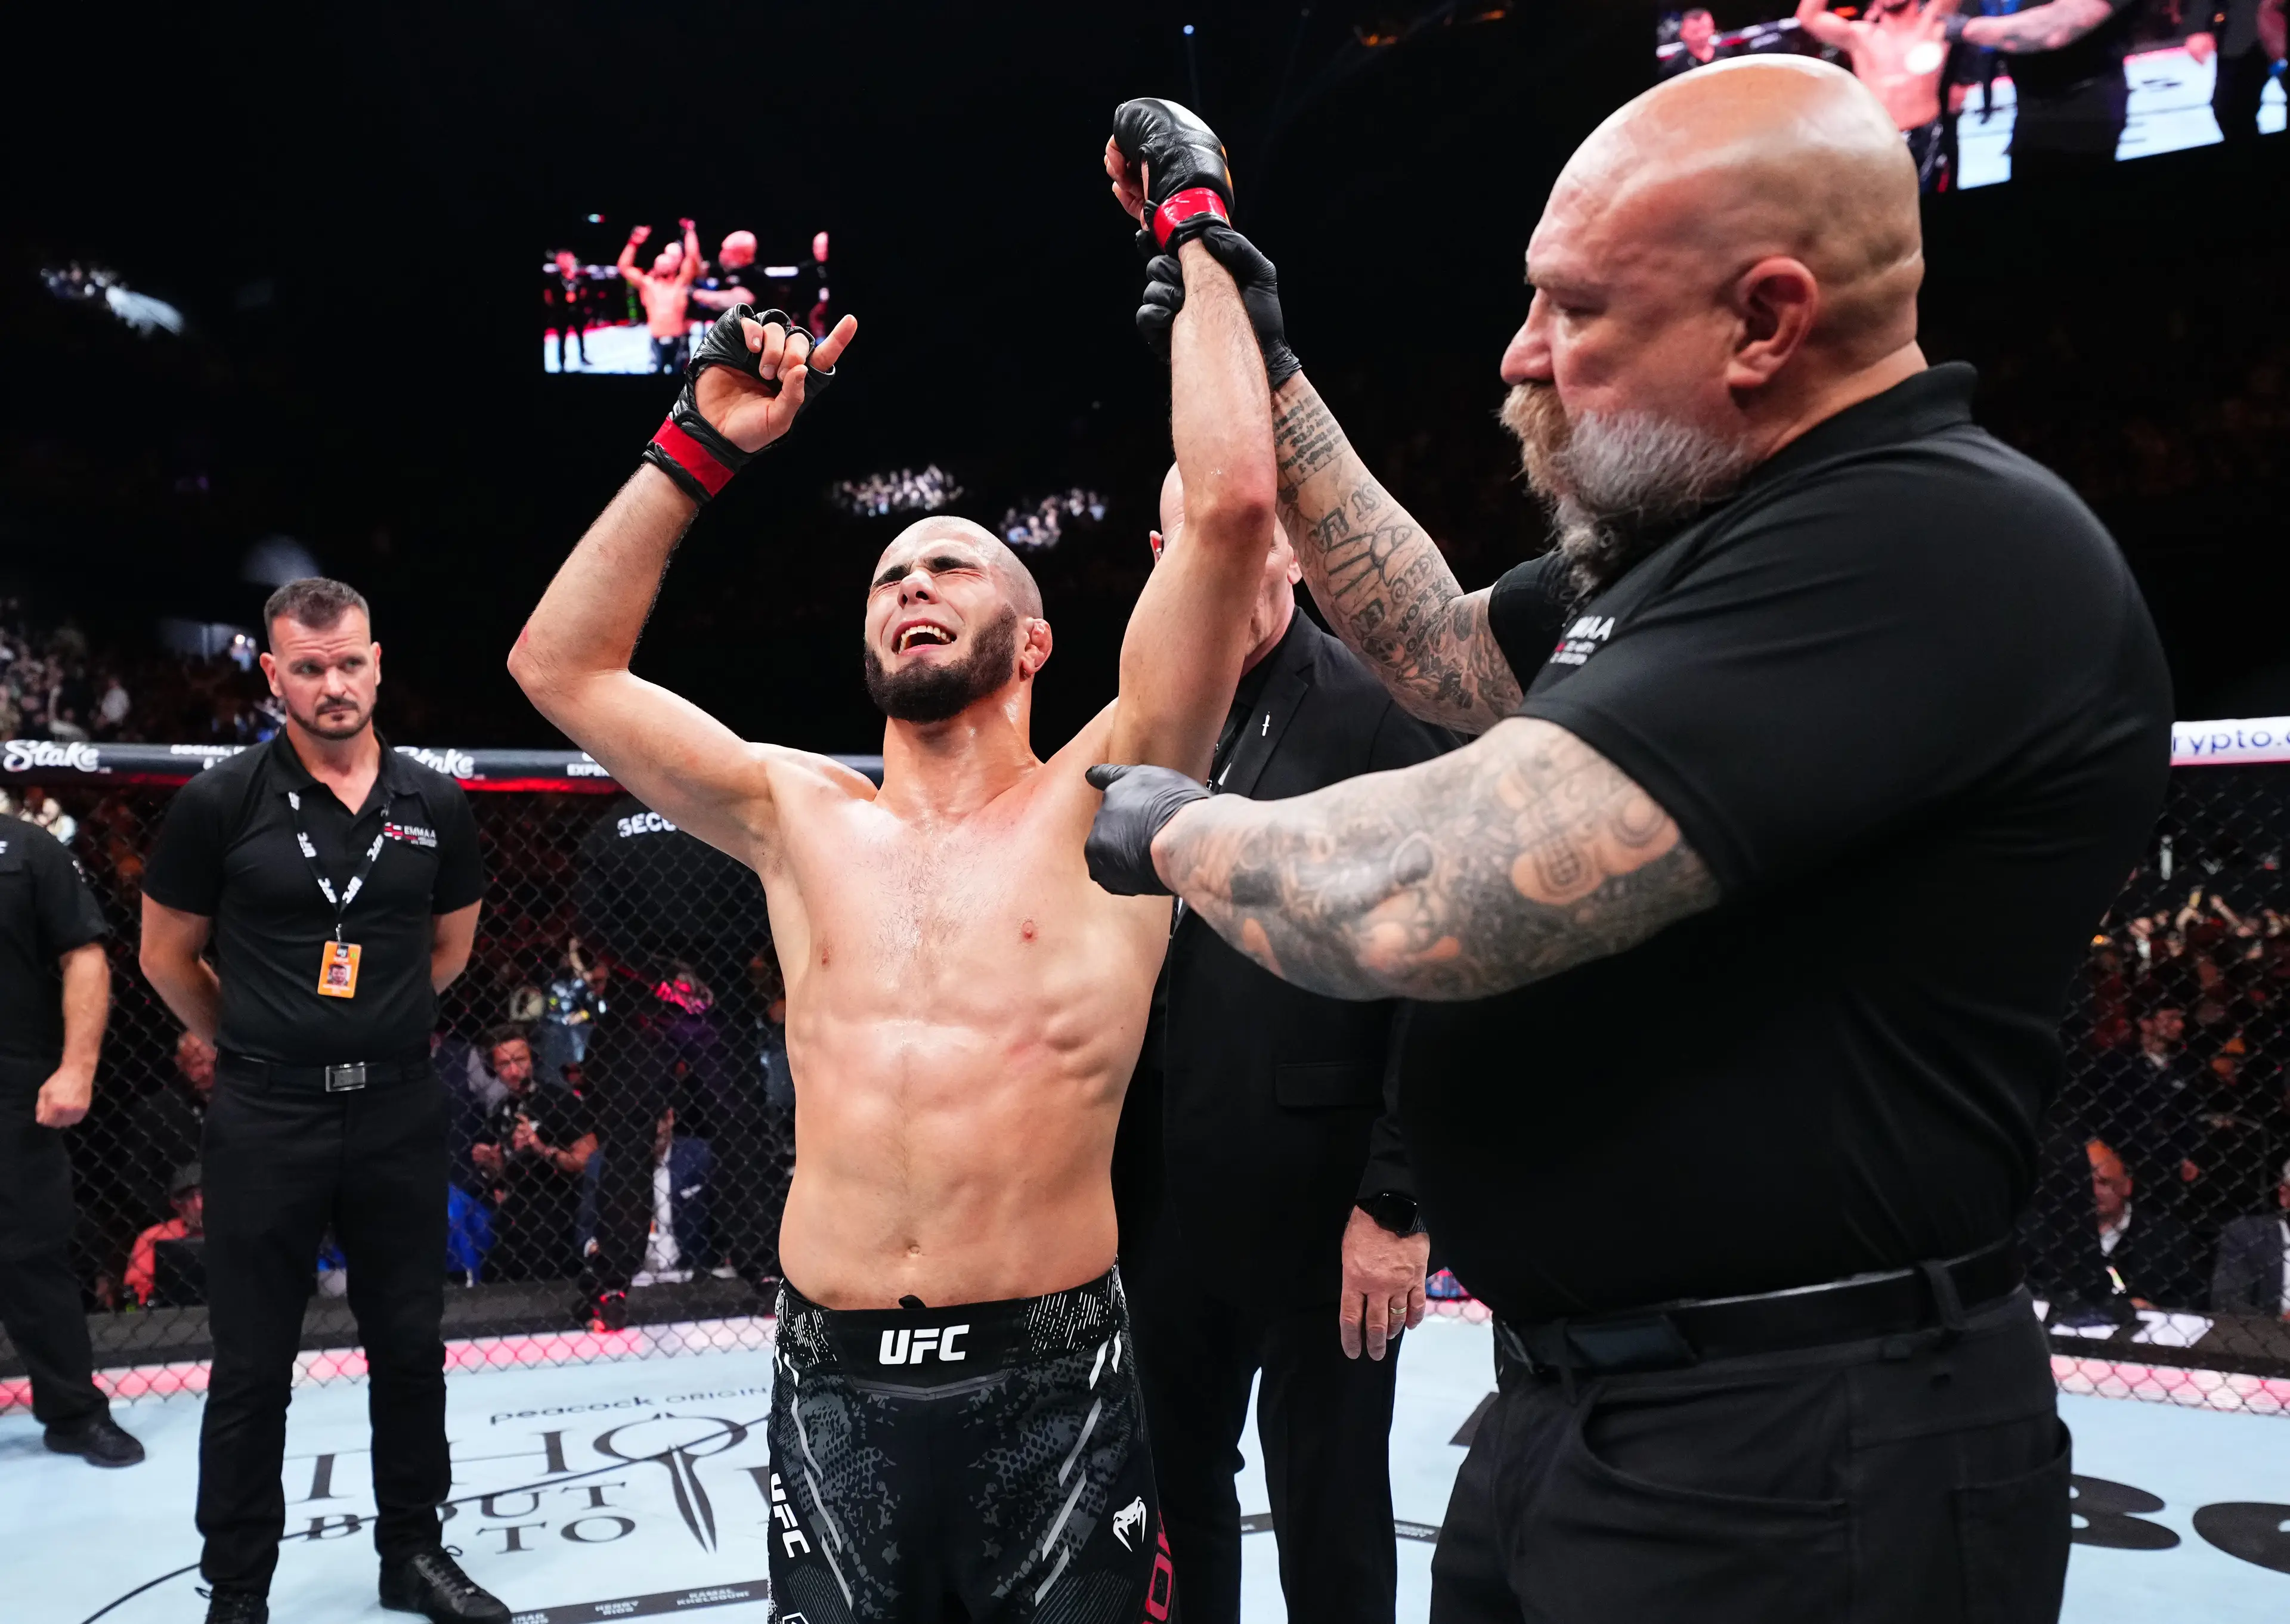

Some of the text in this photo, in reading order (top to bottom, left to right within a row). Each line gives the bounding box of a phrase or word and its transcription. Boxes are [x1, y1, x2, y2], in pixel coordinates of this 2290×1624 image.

[3, 739, 100, 773] Stake
[2171, 729, 2290, 755] rypto.
[404, 825, 437, 839] EMMAA
[878, 1324, 971, 1365] UFC
[490, 1387, 768, 1425] peacock ORIGIN
[770, 1472, 811, 1558] UFC
